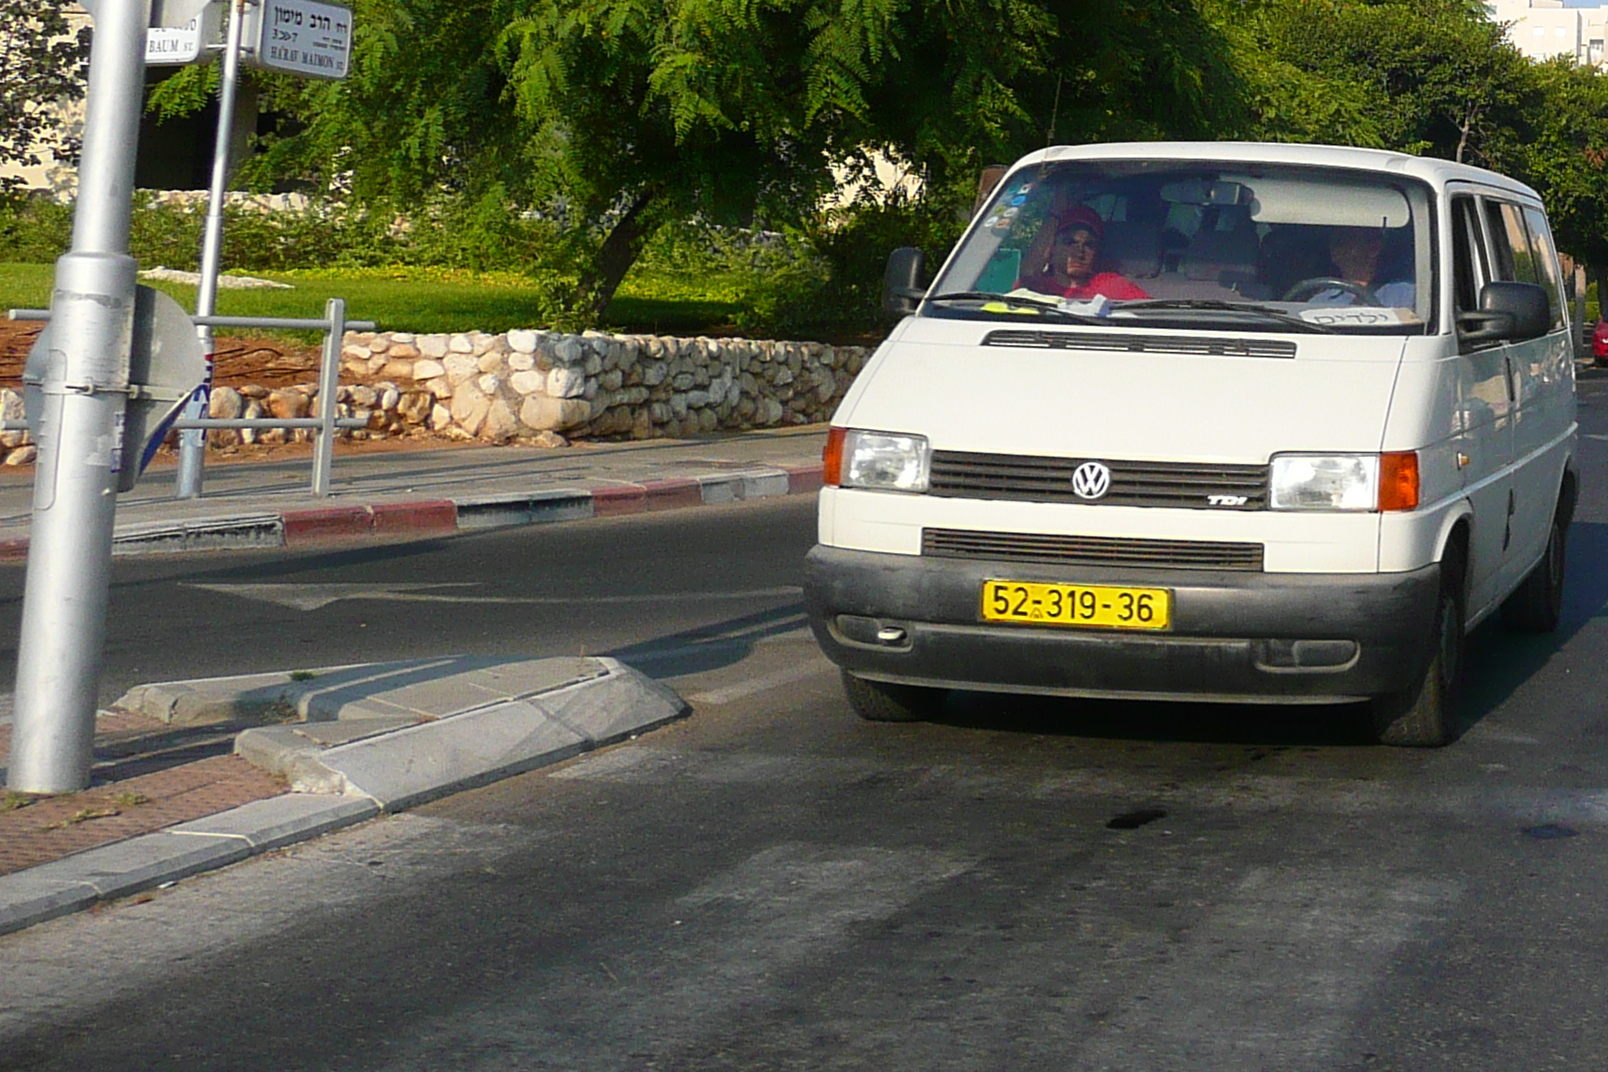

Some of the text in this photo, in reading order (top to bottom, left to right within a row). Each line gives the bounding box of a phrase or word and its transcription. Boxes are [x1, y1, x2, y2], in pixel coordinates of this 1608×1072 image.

[274, 5, 303, 26] מימון
[309, 14, 331, 31] הרב
[1314, 312, 1389, 325] ילדים
[1206, 494, 1248, 506] TDI
[992, 585, 1154, 623] 52-319-36
